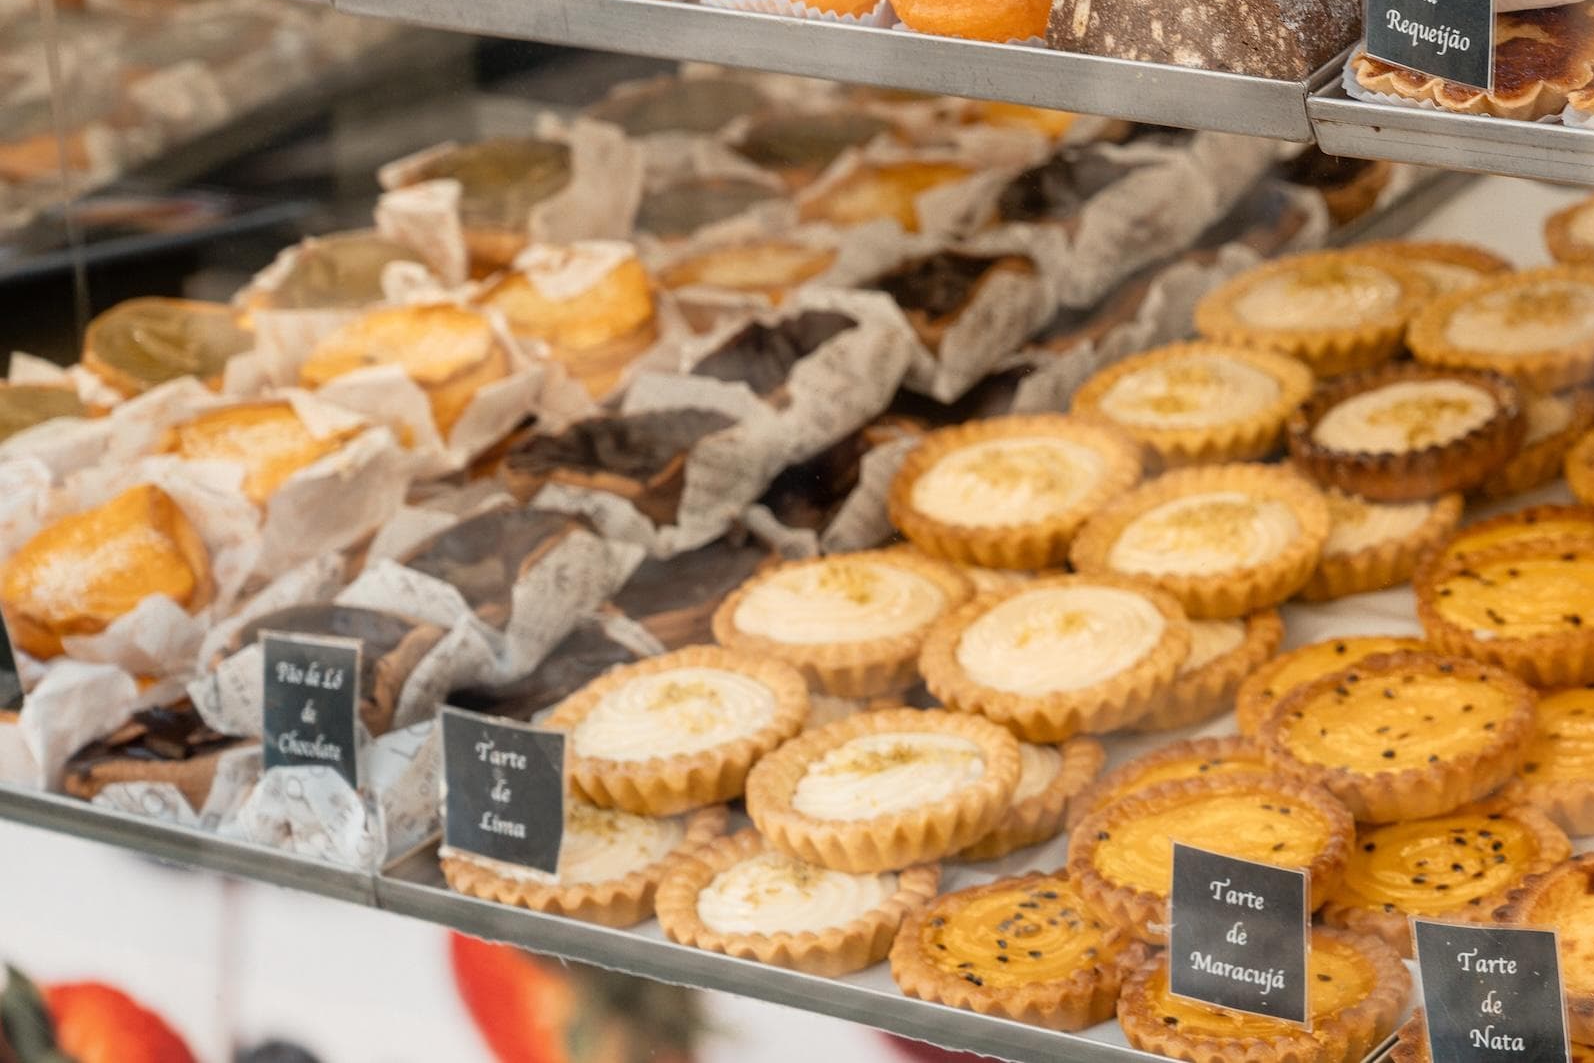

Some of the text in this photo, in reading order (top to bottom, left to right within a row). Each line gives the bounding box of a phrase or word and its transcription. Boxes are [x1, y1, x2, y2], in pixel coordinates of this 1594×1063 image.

[1386, 9, 1471, 56] Requeijão
[301, 698, 317, 725] de
[278, 729, 342, 762] Chocolate
[475, 739, 527, 770] Tarte
[490, 778, 512, 803] de
[478, 811, 527, 839] Lima
[1209, 878, 1265, 910] Tarte
[1226, 921, 1248, 946] de
[1190, 951, 1286, 995] Maracujá
[1457, 948, 1518, 975] Tarte
[1481, 990, 1503, 1015] de
[1469, 1025, 1525, 1051] Nata
